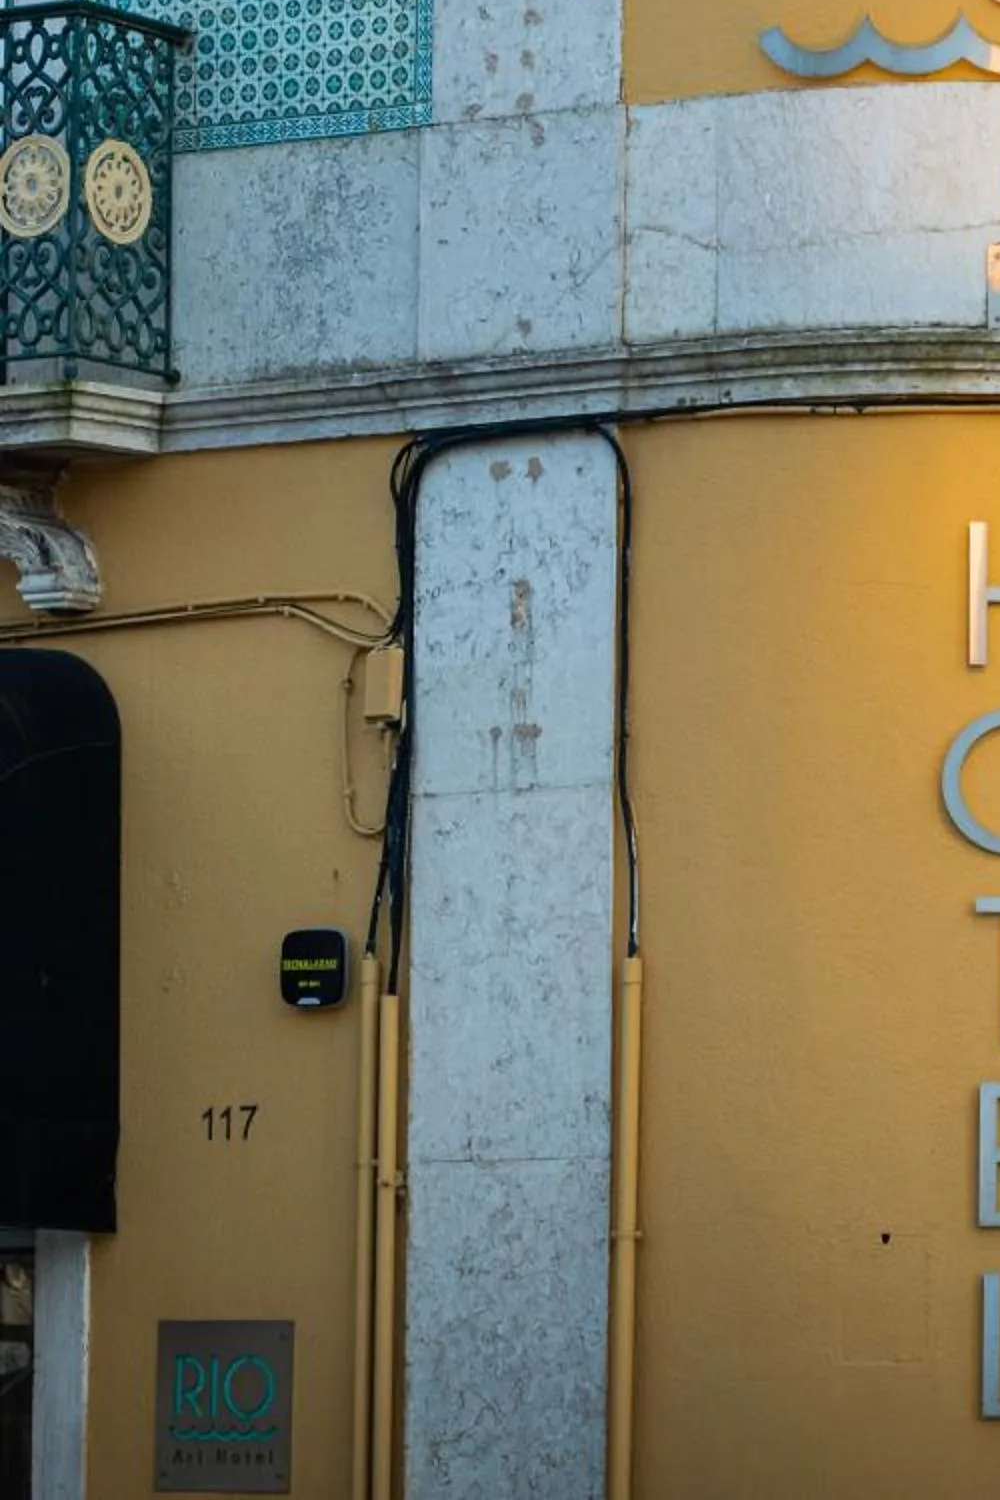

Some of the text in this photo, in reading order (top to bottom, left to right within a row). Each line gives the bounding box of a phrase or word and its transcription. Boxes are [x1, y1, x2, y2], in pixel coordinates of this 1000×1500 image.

[202, 1105, 257, 1141] 117
[174, 1353, 275, 1421] RIO
[172, 1449, 273, 1465] Art Hotel
